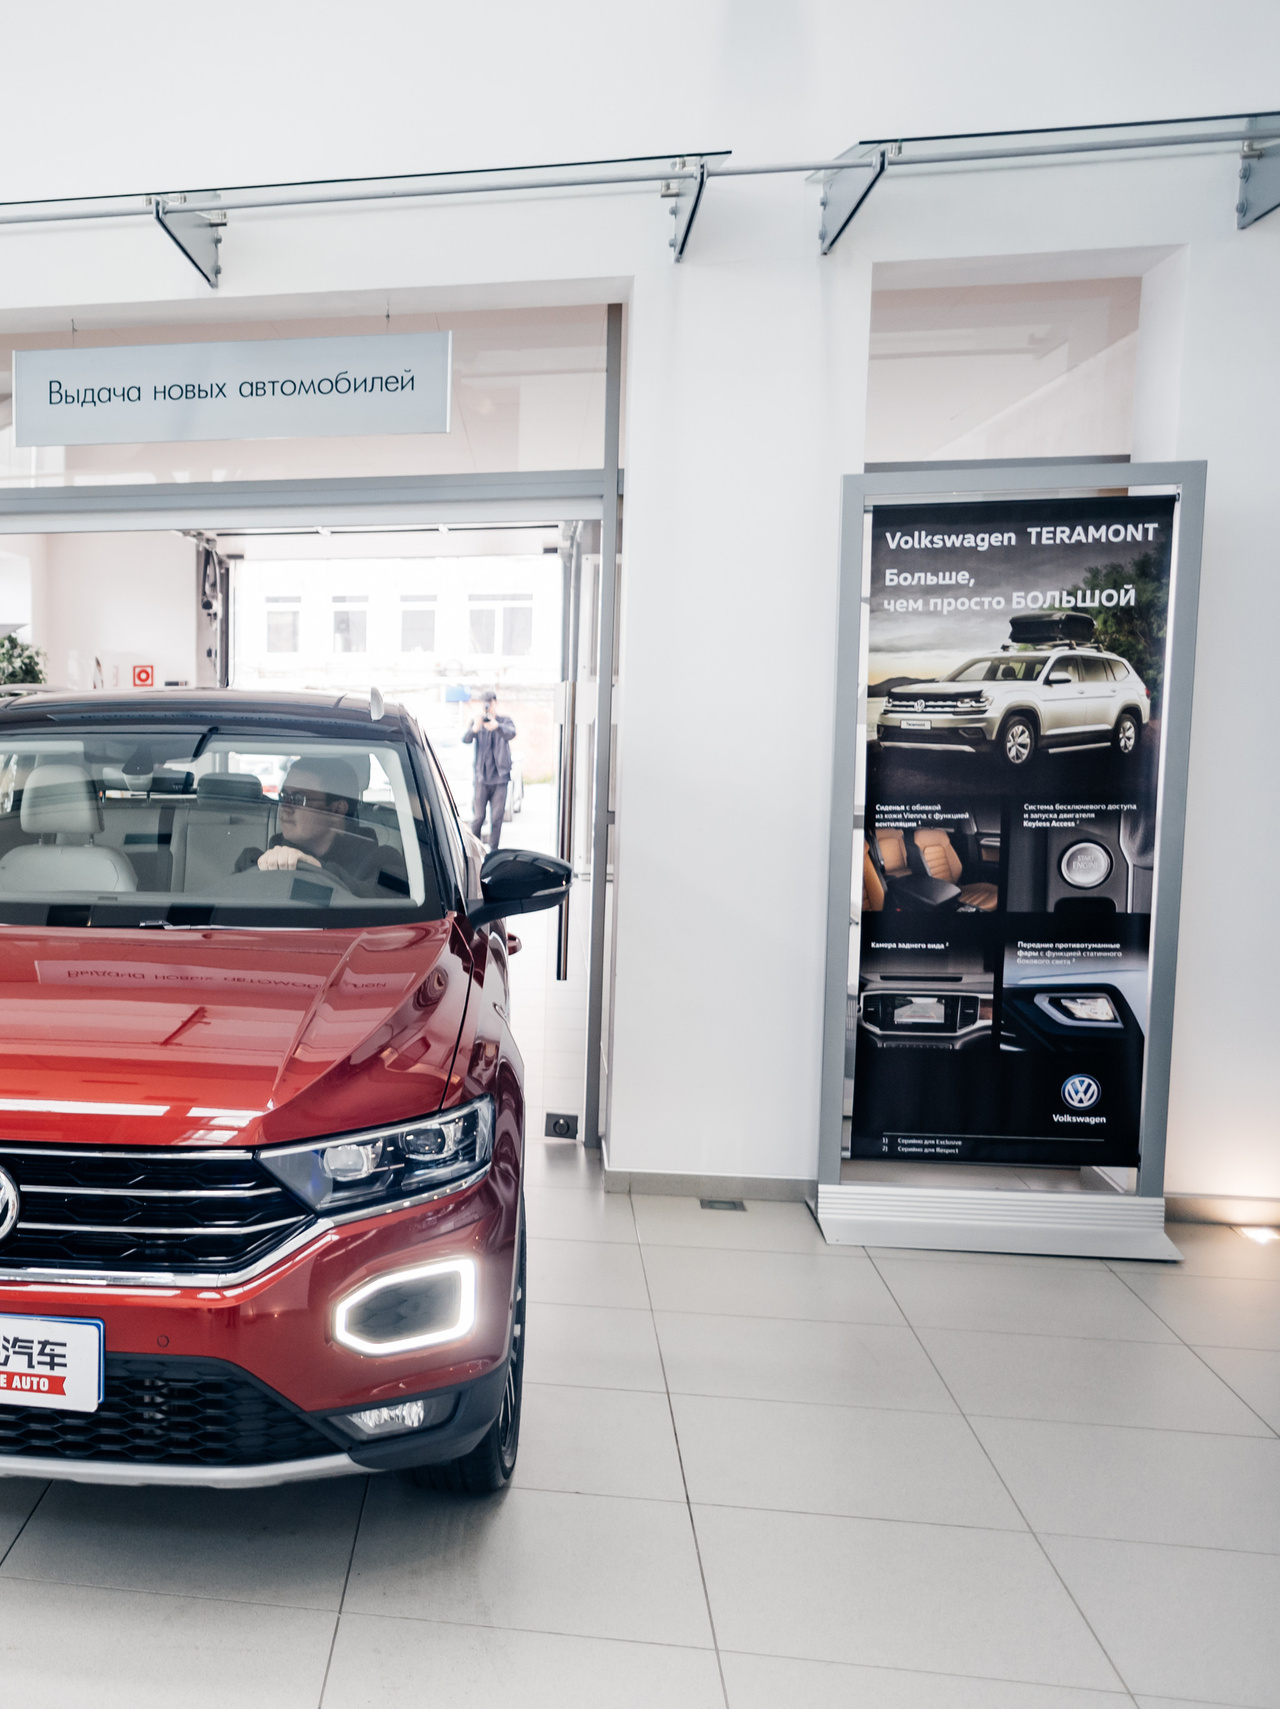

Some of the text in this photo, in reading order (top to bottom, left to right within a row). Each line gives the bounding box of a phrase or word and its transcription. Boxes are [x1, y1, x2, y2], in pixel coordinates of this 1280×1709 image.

[49, 369, 416, 408] Выдача новых автомобилей
[885, 522, 1158, 552] Volkswagen TERAMONT
[885, 568, 975, 588] Больше,
[884, 584, 1136, 615] чем просто БОЛЬШОЙ
[1107, 804, 1137, 812] доступа
[933, 812, 970, 820] функцией
[1023, 820, 1050, 828] Keyless
[871, 941, 897, 949] Камера
[1017, 941, 1120, 950] Передние противотуманные
[1045, 950, 1081, 958] функцией
[1052, 1113, 1106, 1125] Volkswagen
[11, 1376, 49, 1391] AUTO
